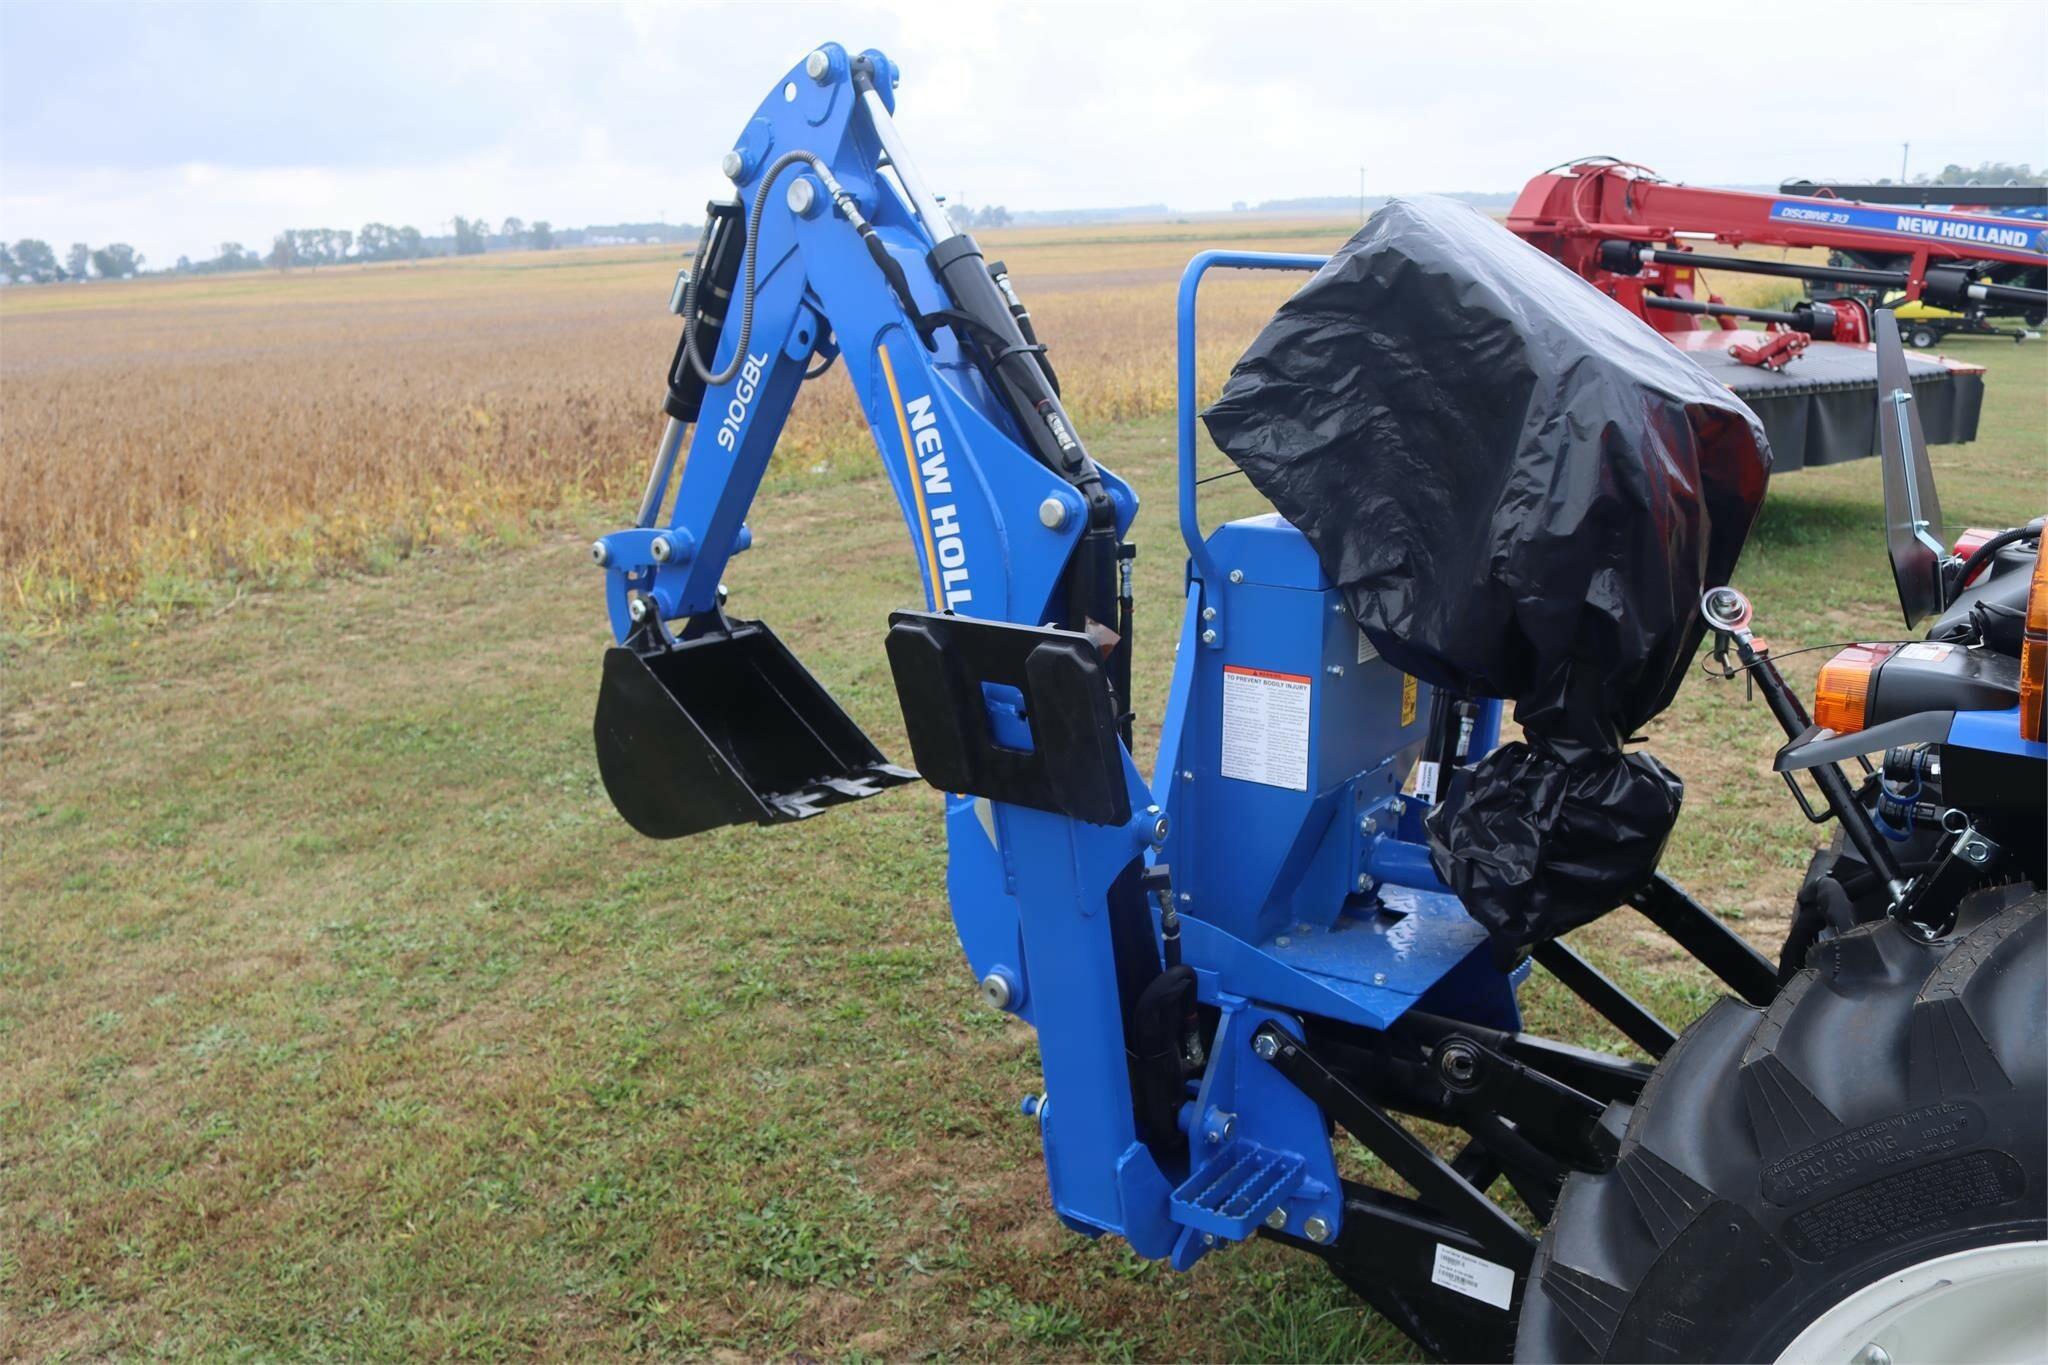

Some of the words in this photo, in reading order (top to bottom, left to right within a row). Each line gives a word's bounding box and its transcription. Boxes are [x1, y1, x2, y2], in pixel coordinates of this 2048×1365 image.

[1781, 207, 1829, 222] DISCBINE
[1829, 212, 1850, 224] 313
[1896, 215, 1937, 235] NEW
[1941, 220, 2029, 248] HOLLAND
[718, 352, 768, 452] 910GBL
[906, 395, 953, 495] NEW
[1236, 675, 1262, 686] PREVENT
[1263, 680, 1284, 688] BODILY
[1285, 683, 1308, 691] INJURY
[1834, 1135, 1898, 1168] RATING
